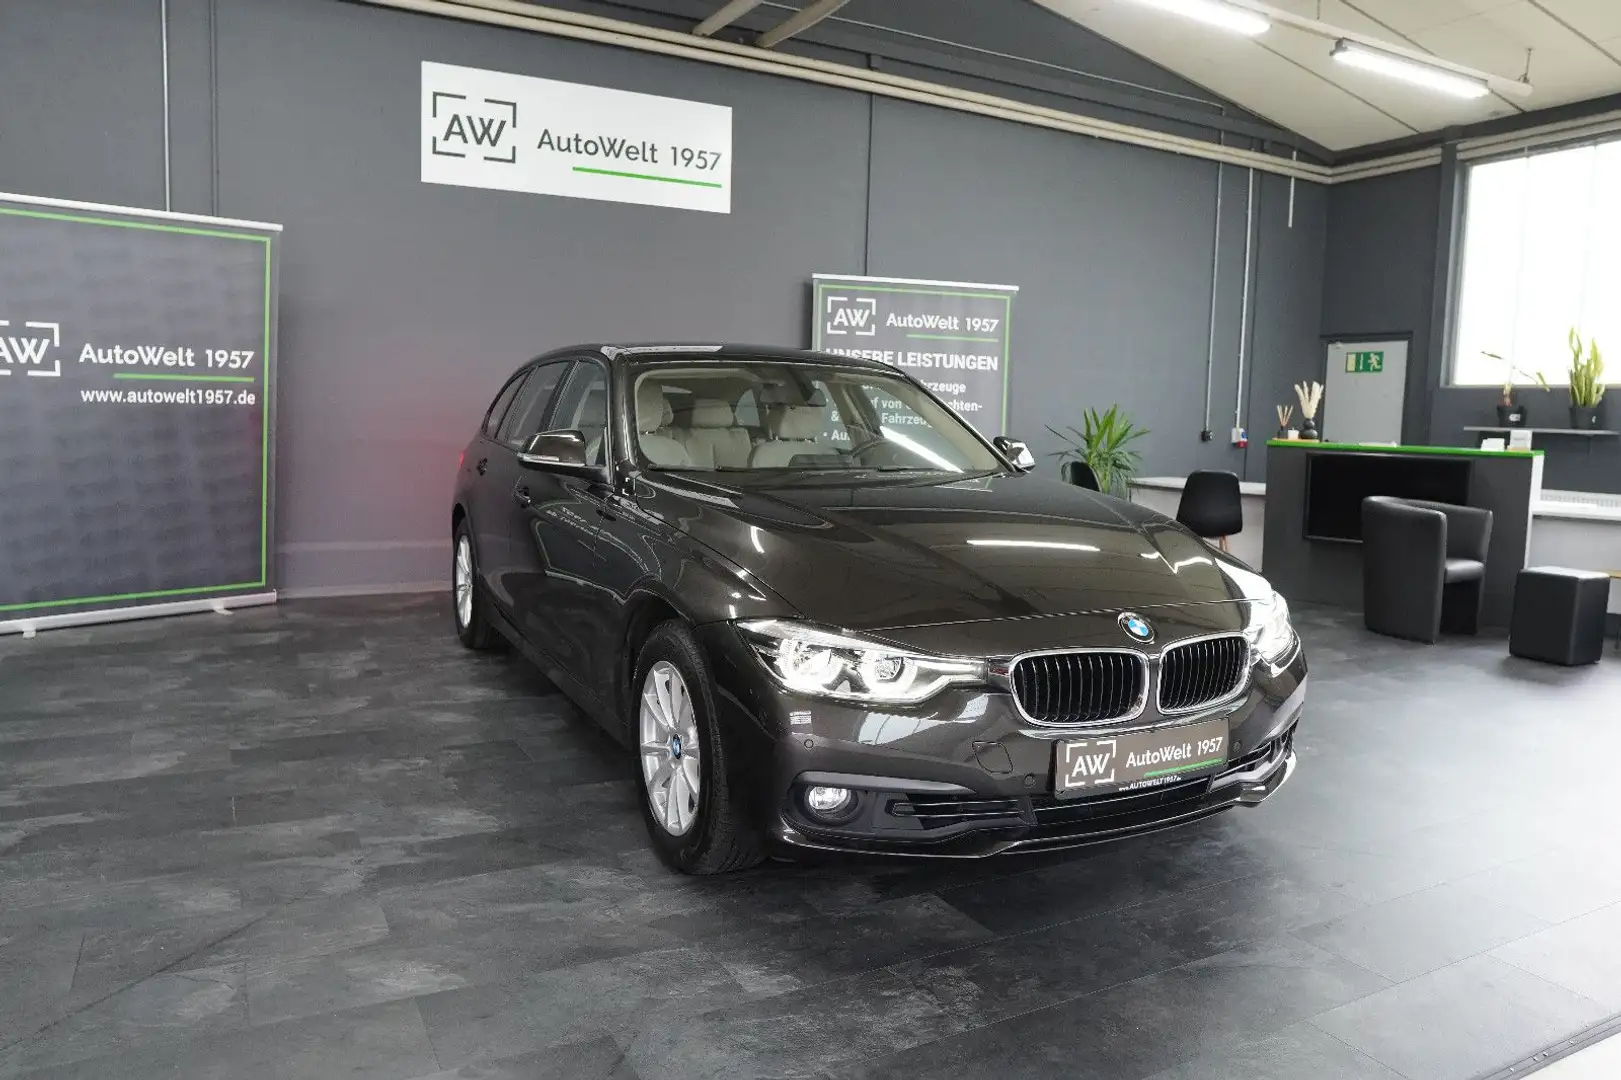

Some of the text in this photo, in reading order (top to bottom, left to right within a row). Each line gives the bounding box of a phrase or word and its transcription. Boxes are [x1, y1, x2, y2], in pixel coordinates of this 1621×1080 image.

[443, 113, 506, 148] AW
[537, 128, 722, 171] AutoWelt 1957
[833, 308, 871, 328] AW
[885, 312, 1000, 333] AutoWelt 1957
[78, 343, 255, 369] AutoWelt 1957
[897, 351, 998, 371] LEISTUNGEN
[80, 388, 256, 405] www.autowelt1957.de
[1126, 736, 1223, 768] AutoWelt 1957
[1071, 753, 1110, 777] AW
